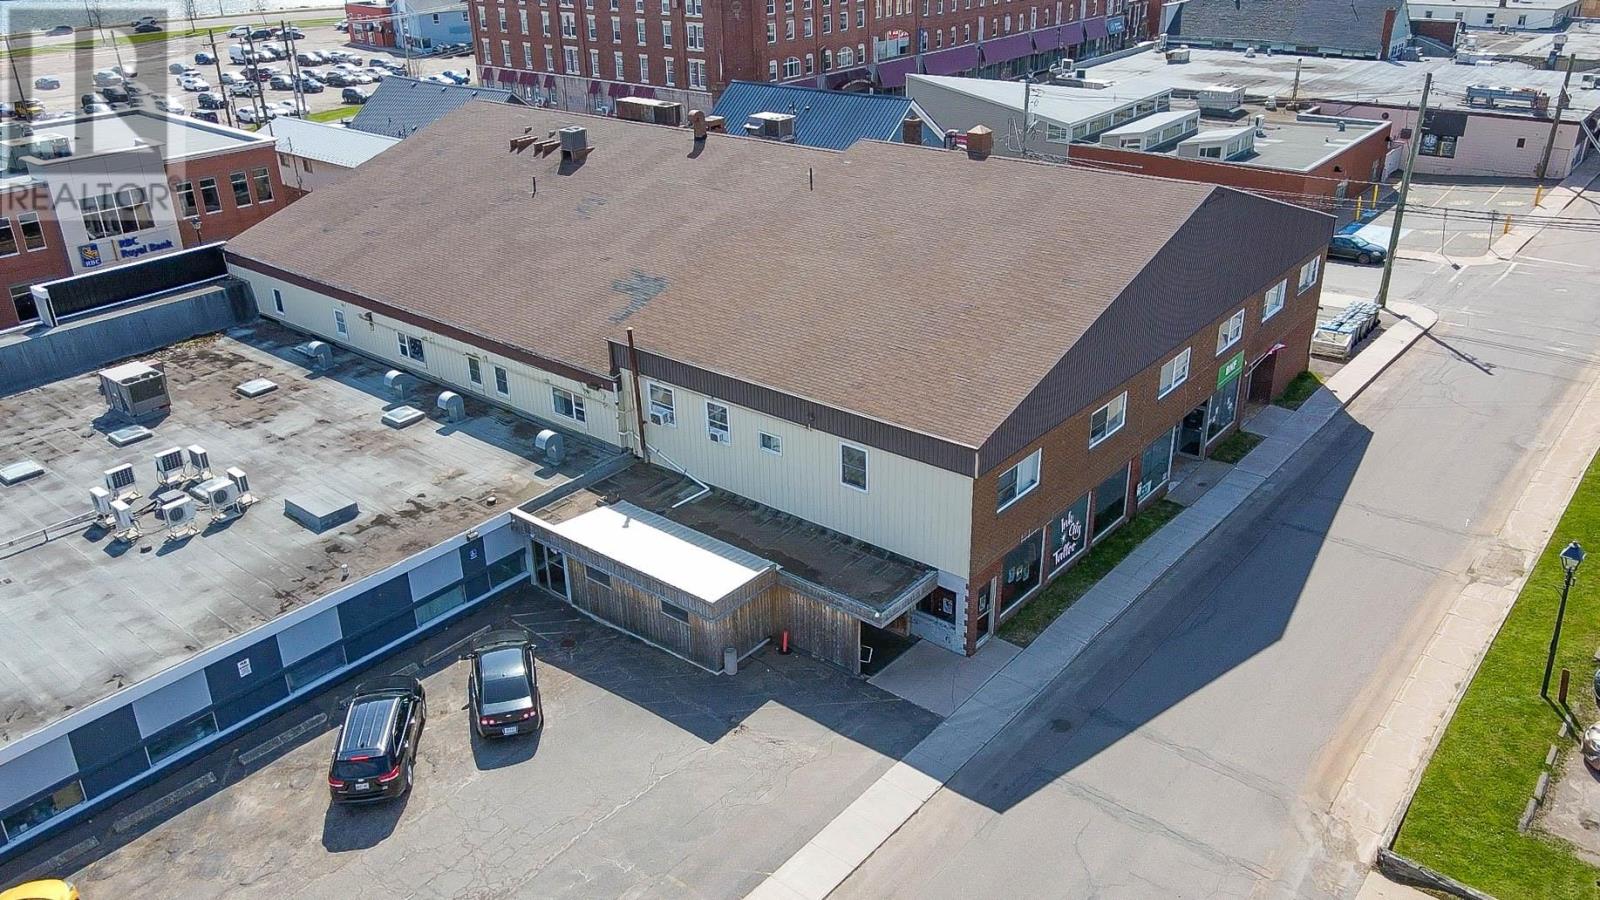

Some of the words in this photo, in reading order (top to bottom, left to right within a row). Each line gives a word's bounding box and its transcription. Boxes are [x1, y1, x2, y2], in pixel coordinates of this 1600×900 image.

[118, 236, 139, 248] RBC
[120, 245, 147, 258] Royal
[148, 239, 174, 252] Bank
